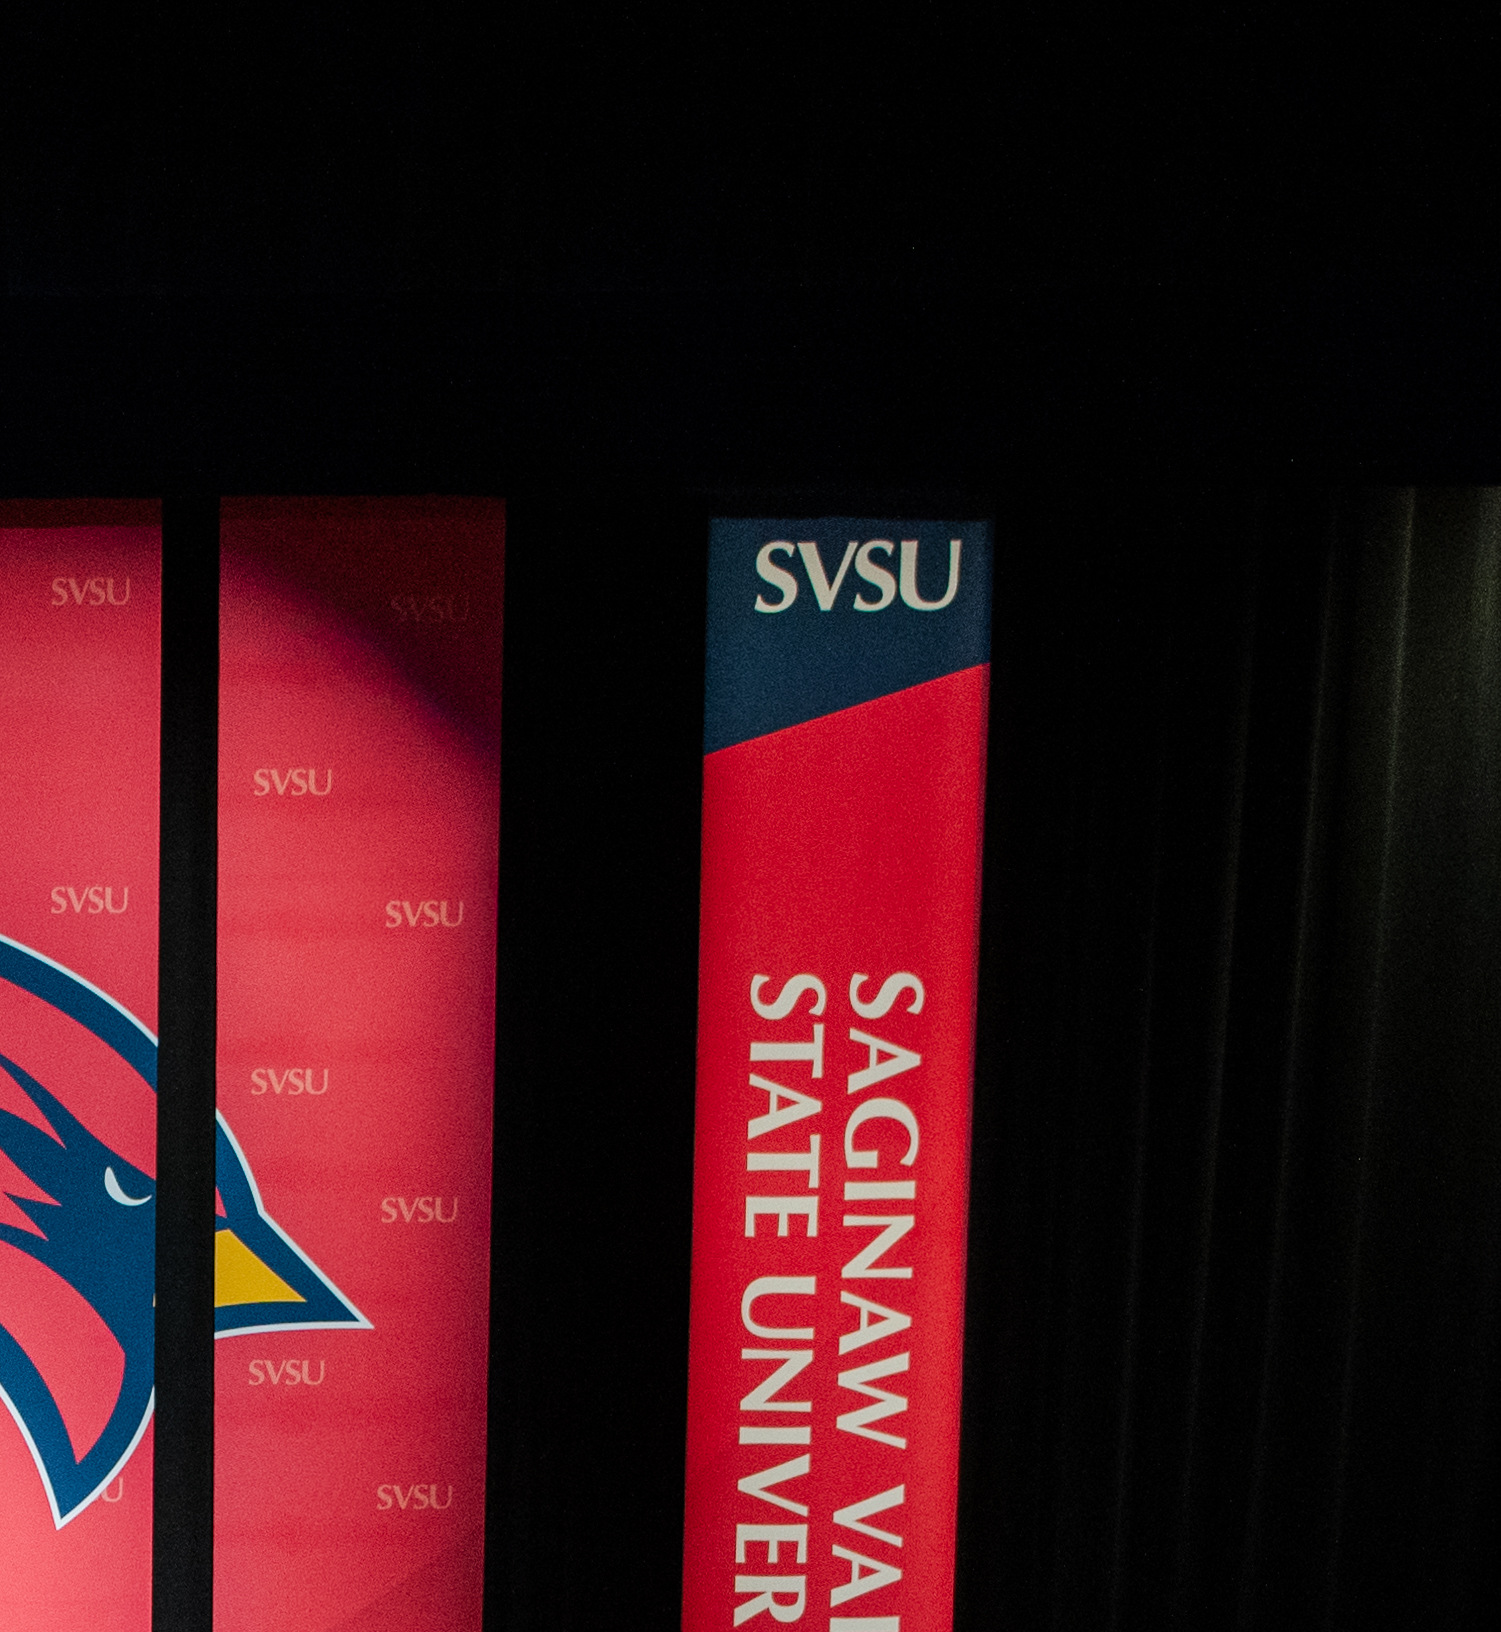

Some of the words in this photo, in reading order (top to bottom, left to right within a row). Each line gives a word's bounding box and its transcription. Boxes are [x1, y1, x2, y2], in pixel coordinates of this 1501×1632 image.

[753, 539, 963, 614] SVSU
[51, 577, 131, 606] SVSU
[390, 594, 470, 622] SVSU
[253, 768, 333, 797] SVSU
[51, 885, 129, 914] SVSU
[384, 899, 464, 928] SVSU
[250, 1067, 330, 1096] SVSU
[744, 973, 827, 1238] STATE
[380, 1195, 459, 1224] SVSU
[835, 971, 925, 1450] SAGINAW
[248, 1359, 326, 1386] SVSU
[375, 1483, 454, 1511] SVSU
